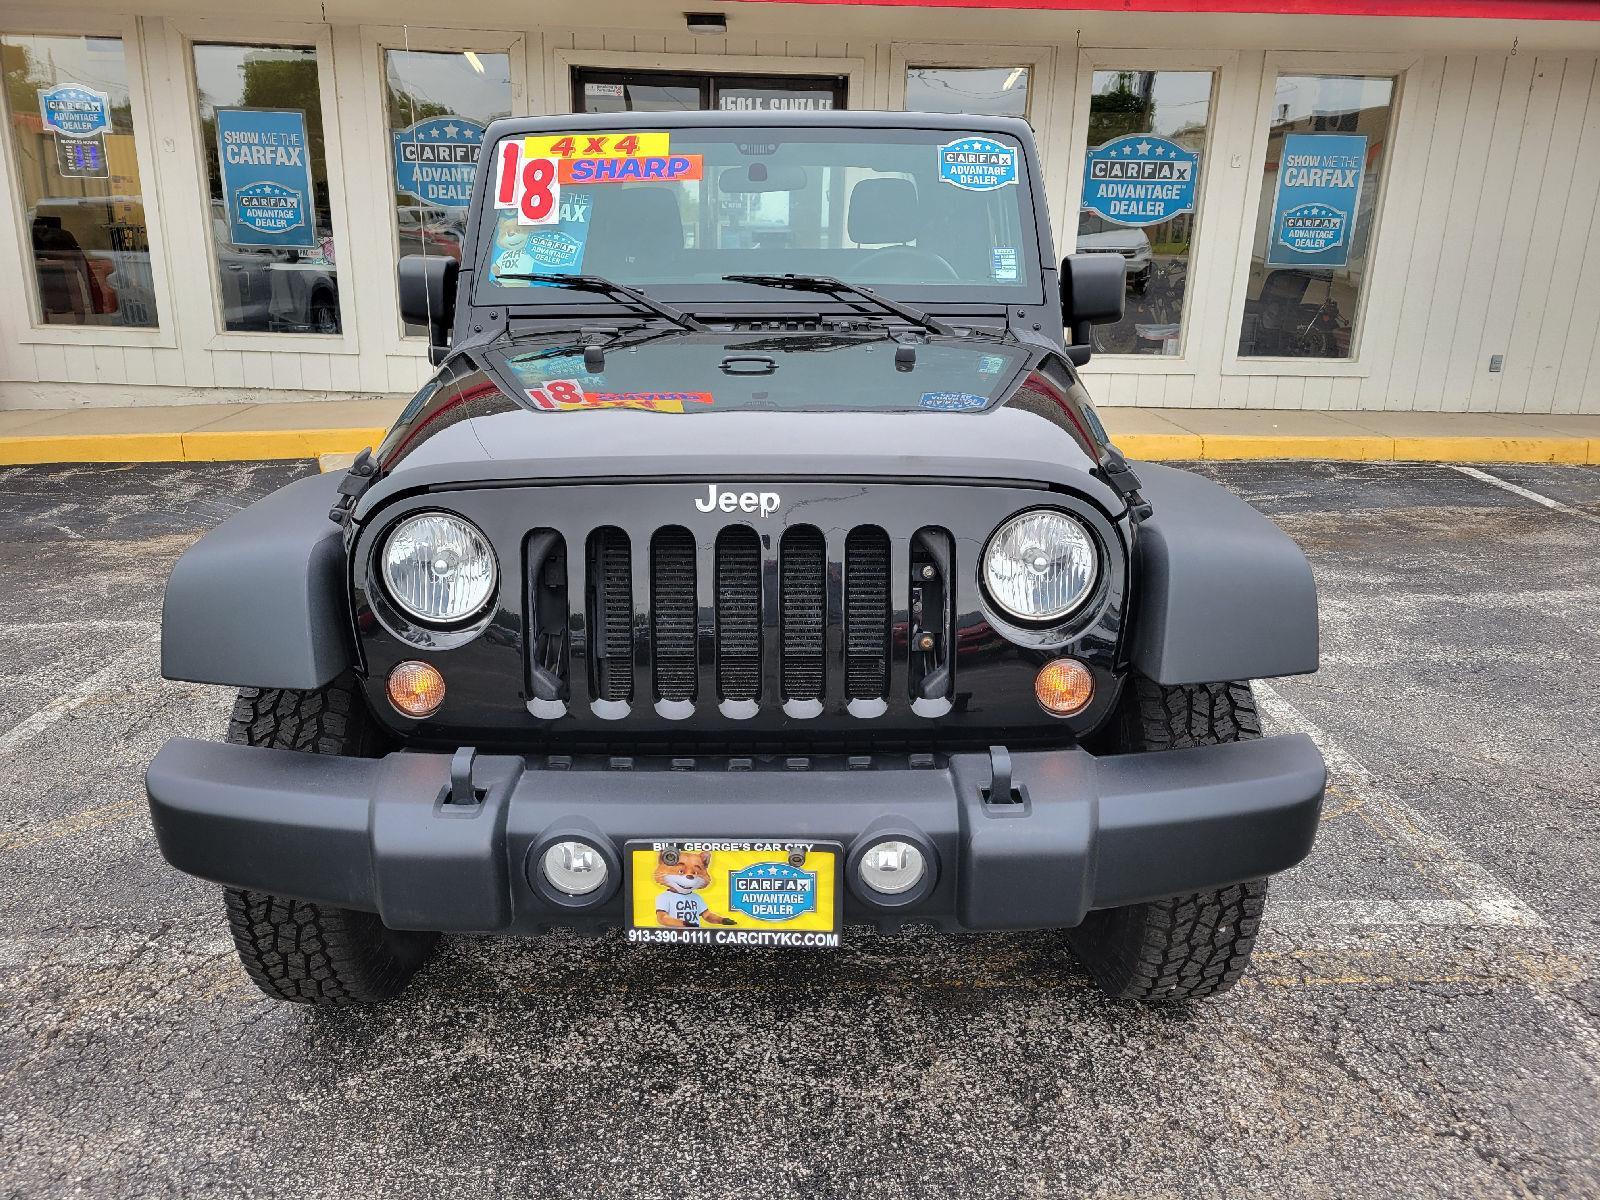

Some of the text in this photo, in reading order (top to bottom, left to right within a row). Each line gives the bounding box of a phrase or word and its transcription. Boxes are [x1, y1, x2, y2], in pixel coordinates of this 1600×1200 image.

[49, 101, 99, 111] CARFAX
[720, 97, 752, 110] 1501
[770, 98, 814, 110] SANTA
[819, 100, 832, 110] FE
[54, 113, 99, 121] ADVANTAGE
[224, 131, 300, 146] SHOW ME THE
[226, 145, 302, 166] CARFAX
[946, 153, 1010, 165] CARFAX
[1287, 155, 1359, 168] SHOW ME THE
[571, 157, 692, 182] SHARP
[950, 166, 1007, 176] ADVANTAGE
[1094, 163, 1188, 180] CARFAX
[960, 175, 998, 185] DEALER
[1285, 168, 1357, 187] CARFAX
[242, 198, 295, 207] CARFAX
[568, 193, 590, 205] THE
[1110, 201, 1165, 215] DEALER
[246, 209, 294, 218] ADVANTAGE
[256, 219, 287, 227] DEALER
[1287, 219, 1339, 229] CARFAX
[1288, 230, 1334, 239] ADVANTAGE
[1295, 239, 1325, 248] DEALER
[531, 246, 571, 260] ADVANTAGE
[535, 254, 561, 265] DEALER
[694, 484, 781, 518] Jeep
[684, 843, 750, 852] GEORGE'S
[754, 843, 782, 852] CAR
[738, 880, 808, 892] CARFAX
[742, 894, 804, 903] ADVANTAGE
[676, 901, 698, 910] CAR
[752, 905, 793, 915] DEALER
[677, 911, 698, 921] FOX
[628, 930, 839, 947] 913-390-0111 CARCITYKC.COM
